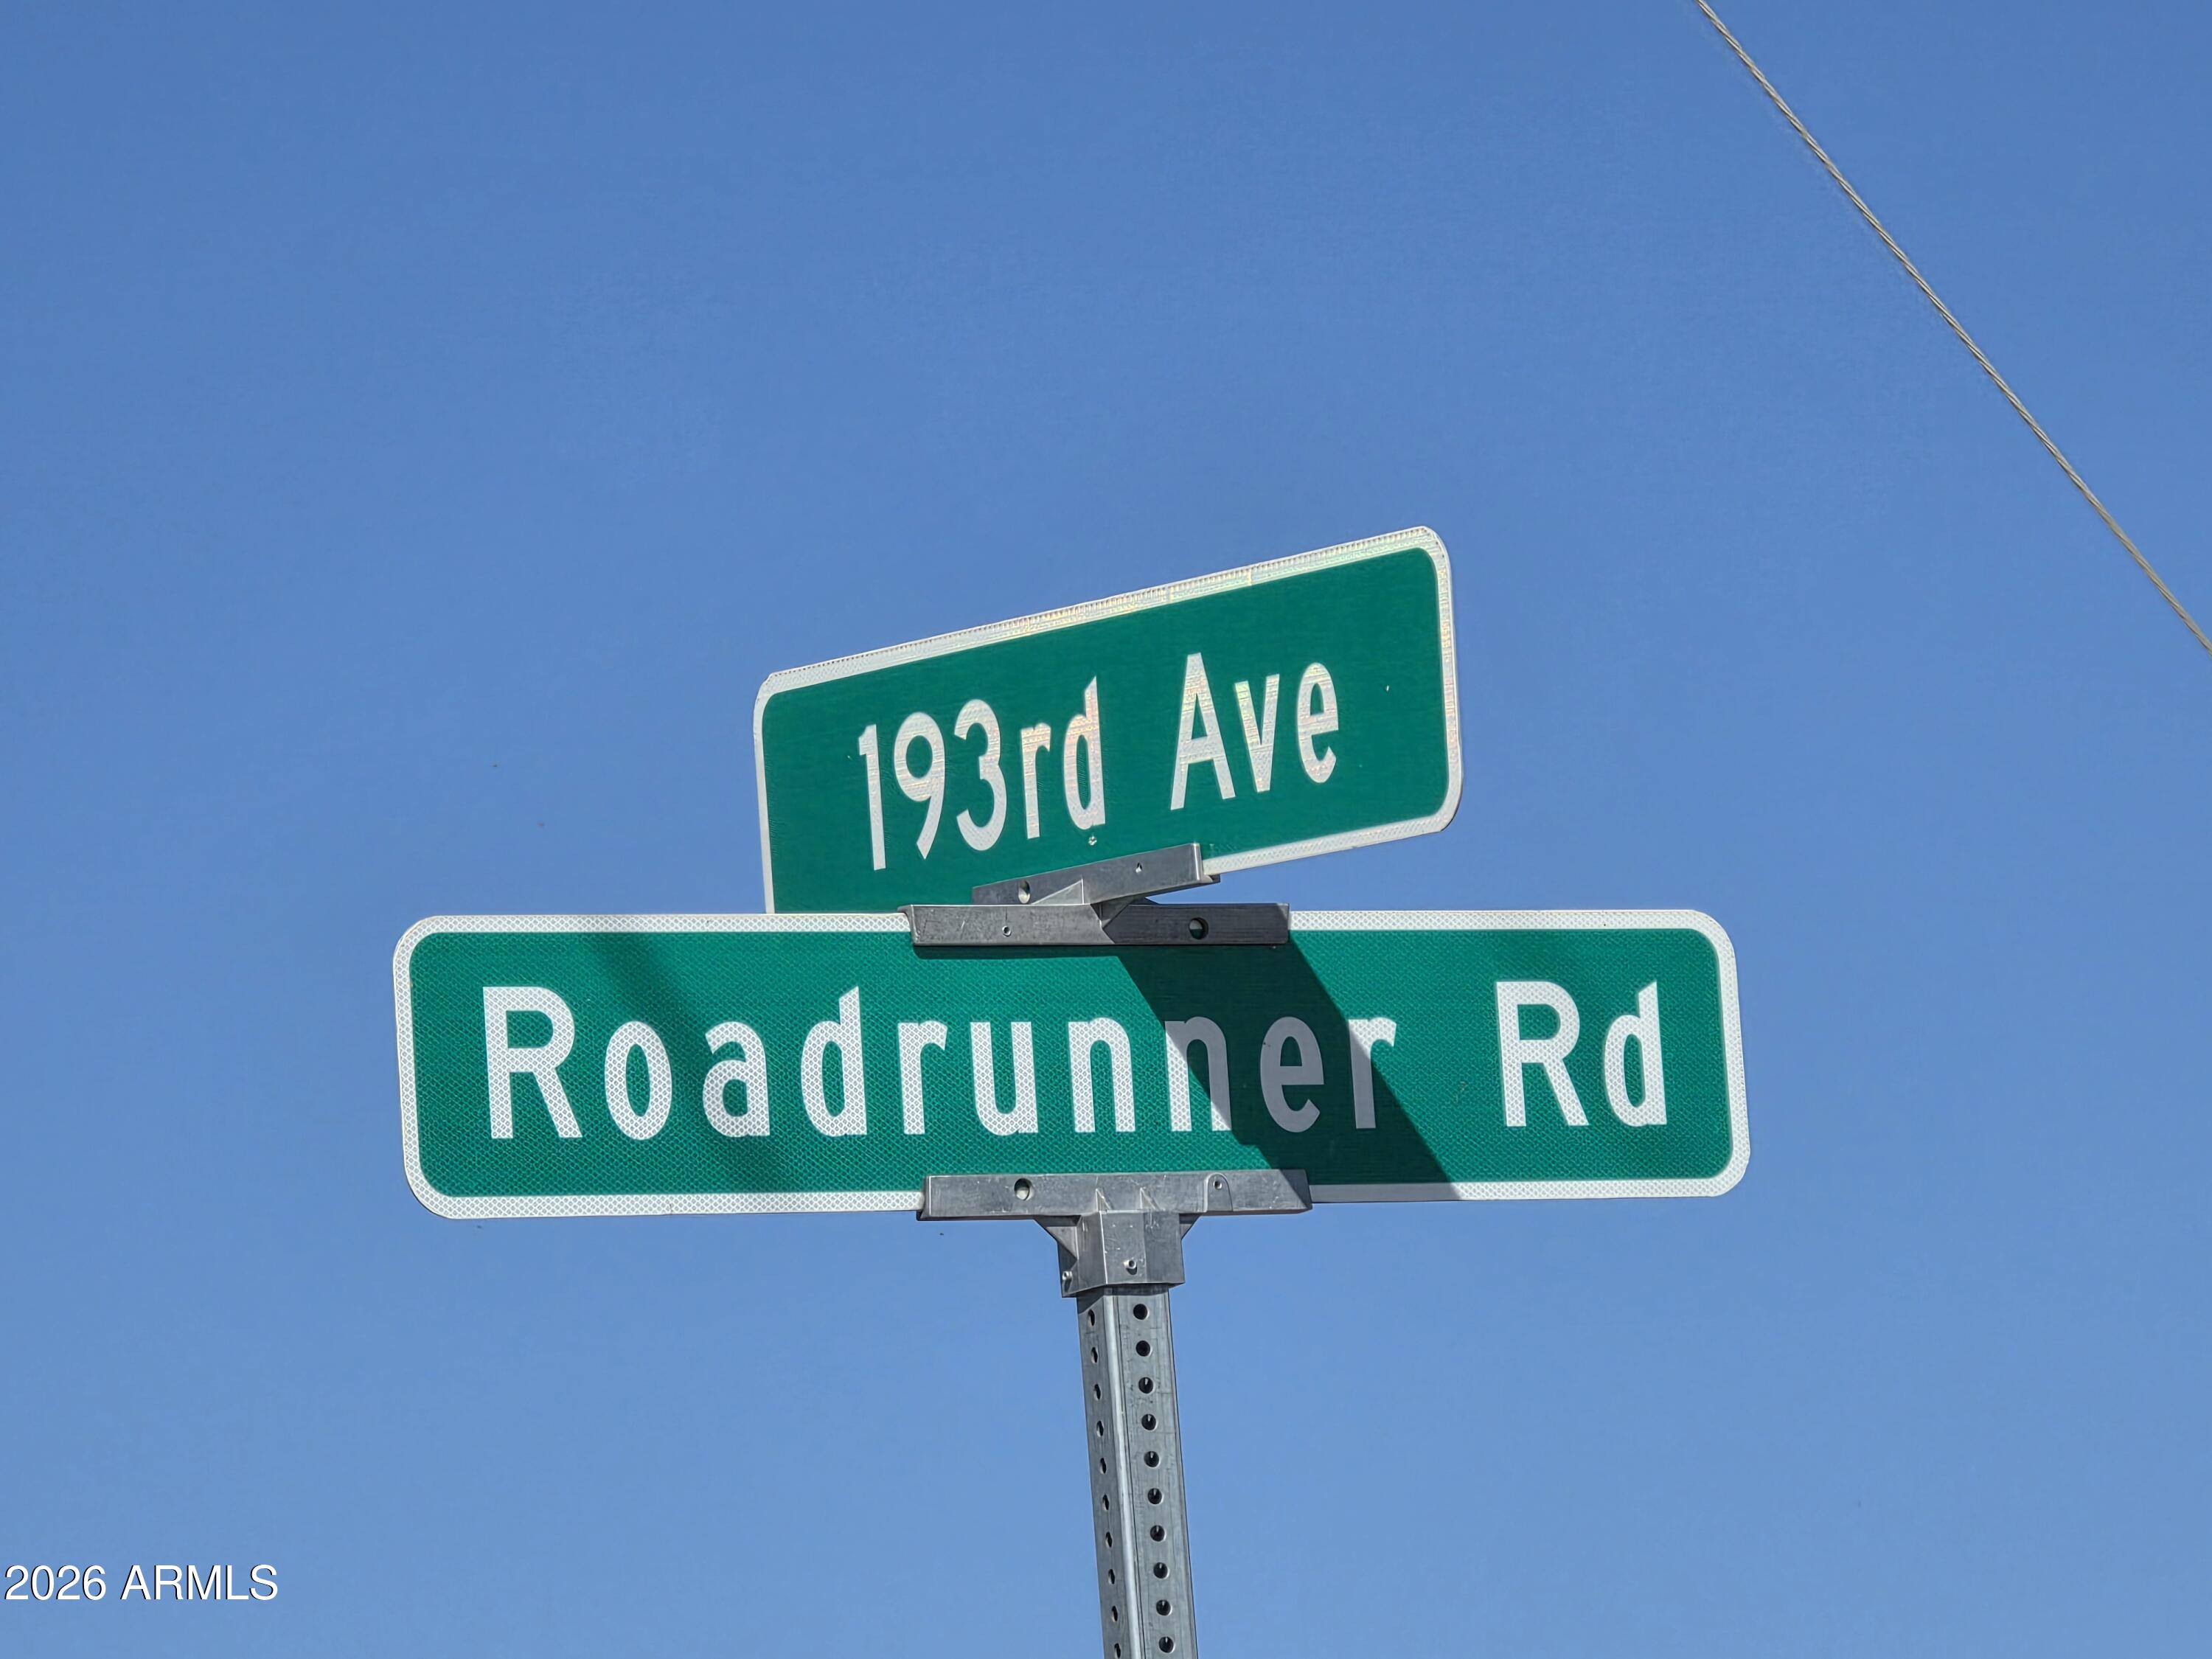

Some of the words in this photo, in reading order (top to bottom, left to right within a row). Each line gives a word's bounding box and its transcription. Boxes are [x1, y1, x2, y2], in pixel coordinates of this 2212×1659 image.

[858, 675, 1106, 871] 193rd
[1170, 653, 1339, 810] Ave
[482, 986, 1397, 1141] Roadrunner
[1495, 981, 1667, 1127] Rd
